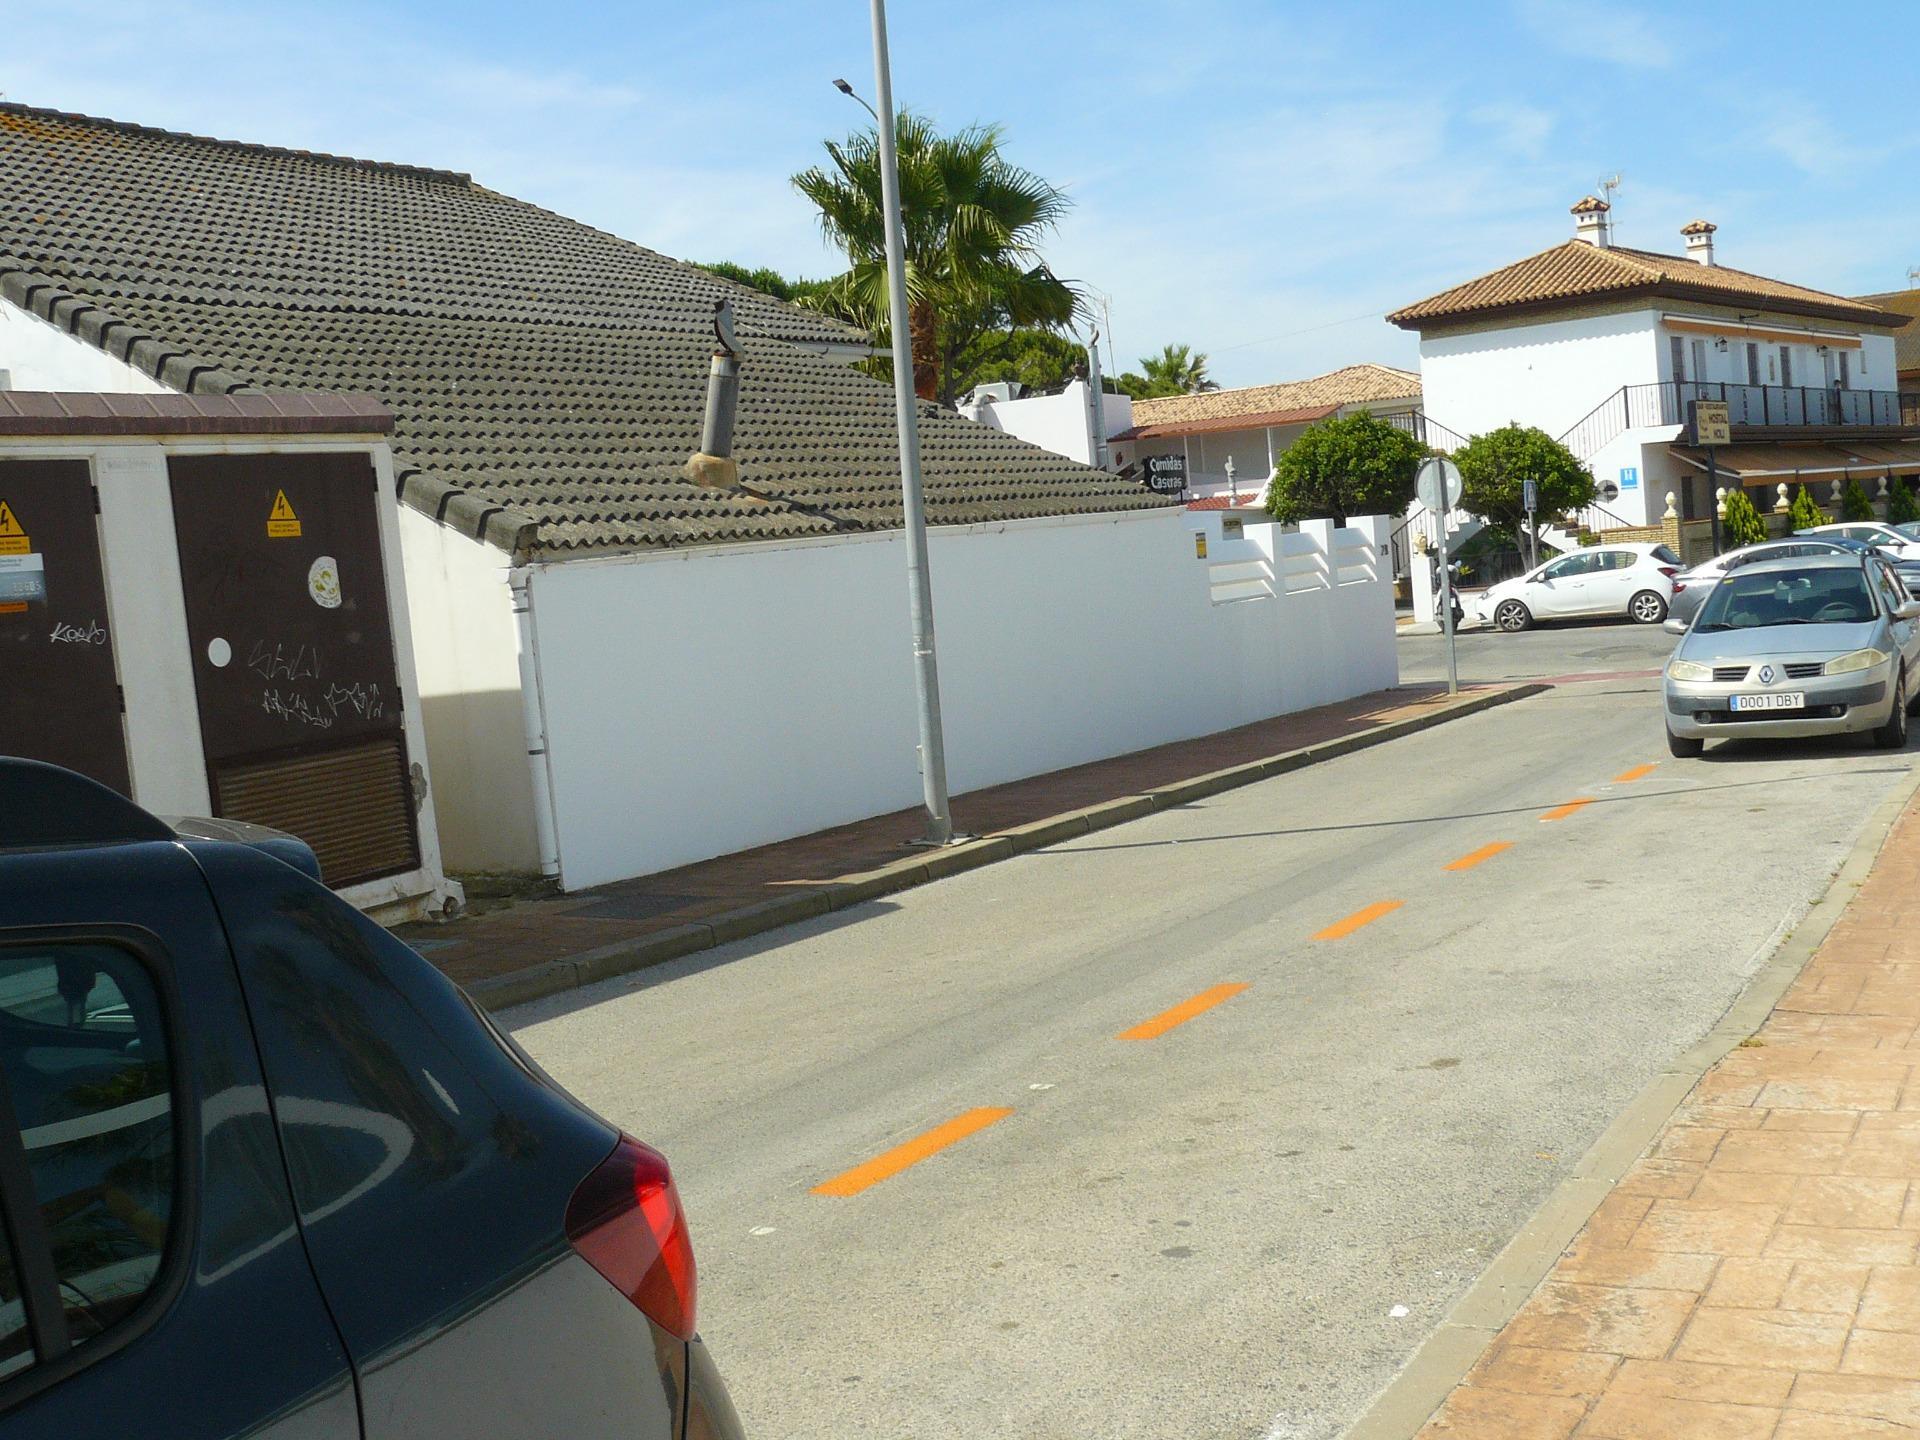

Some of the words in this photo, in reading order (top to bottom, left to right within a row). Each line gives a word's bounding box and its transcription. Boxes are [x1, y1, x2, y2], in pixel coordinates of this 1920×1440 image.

[1709, 413, 1728, 424] HOSTAL
[1150, 456, 1183, 472] Comidas
[1740, 696, 1771, 709] 0001
[1776, 694, 1801, 707] DBY
